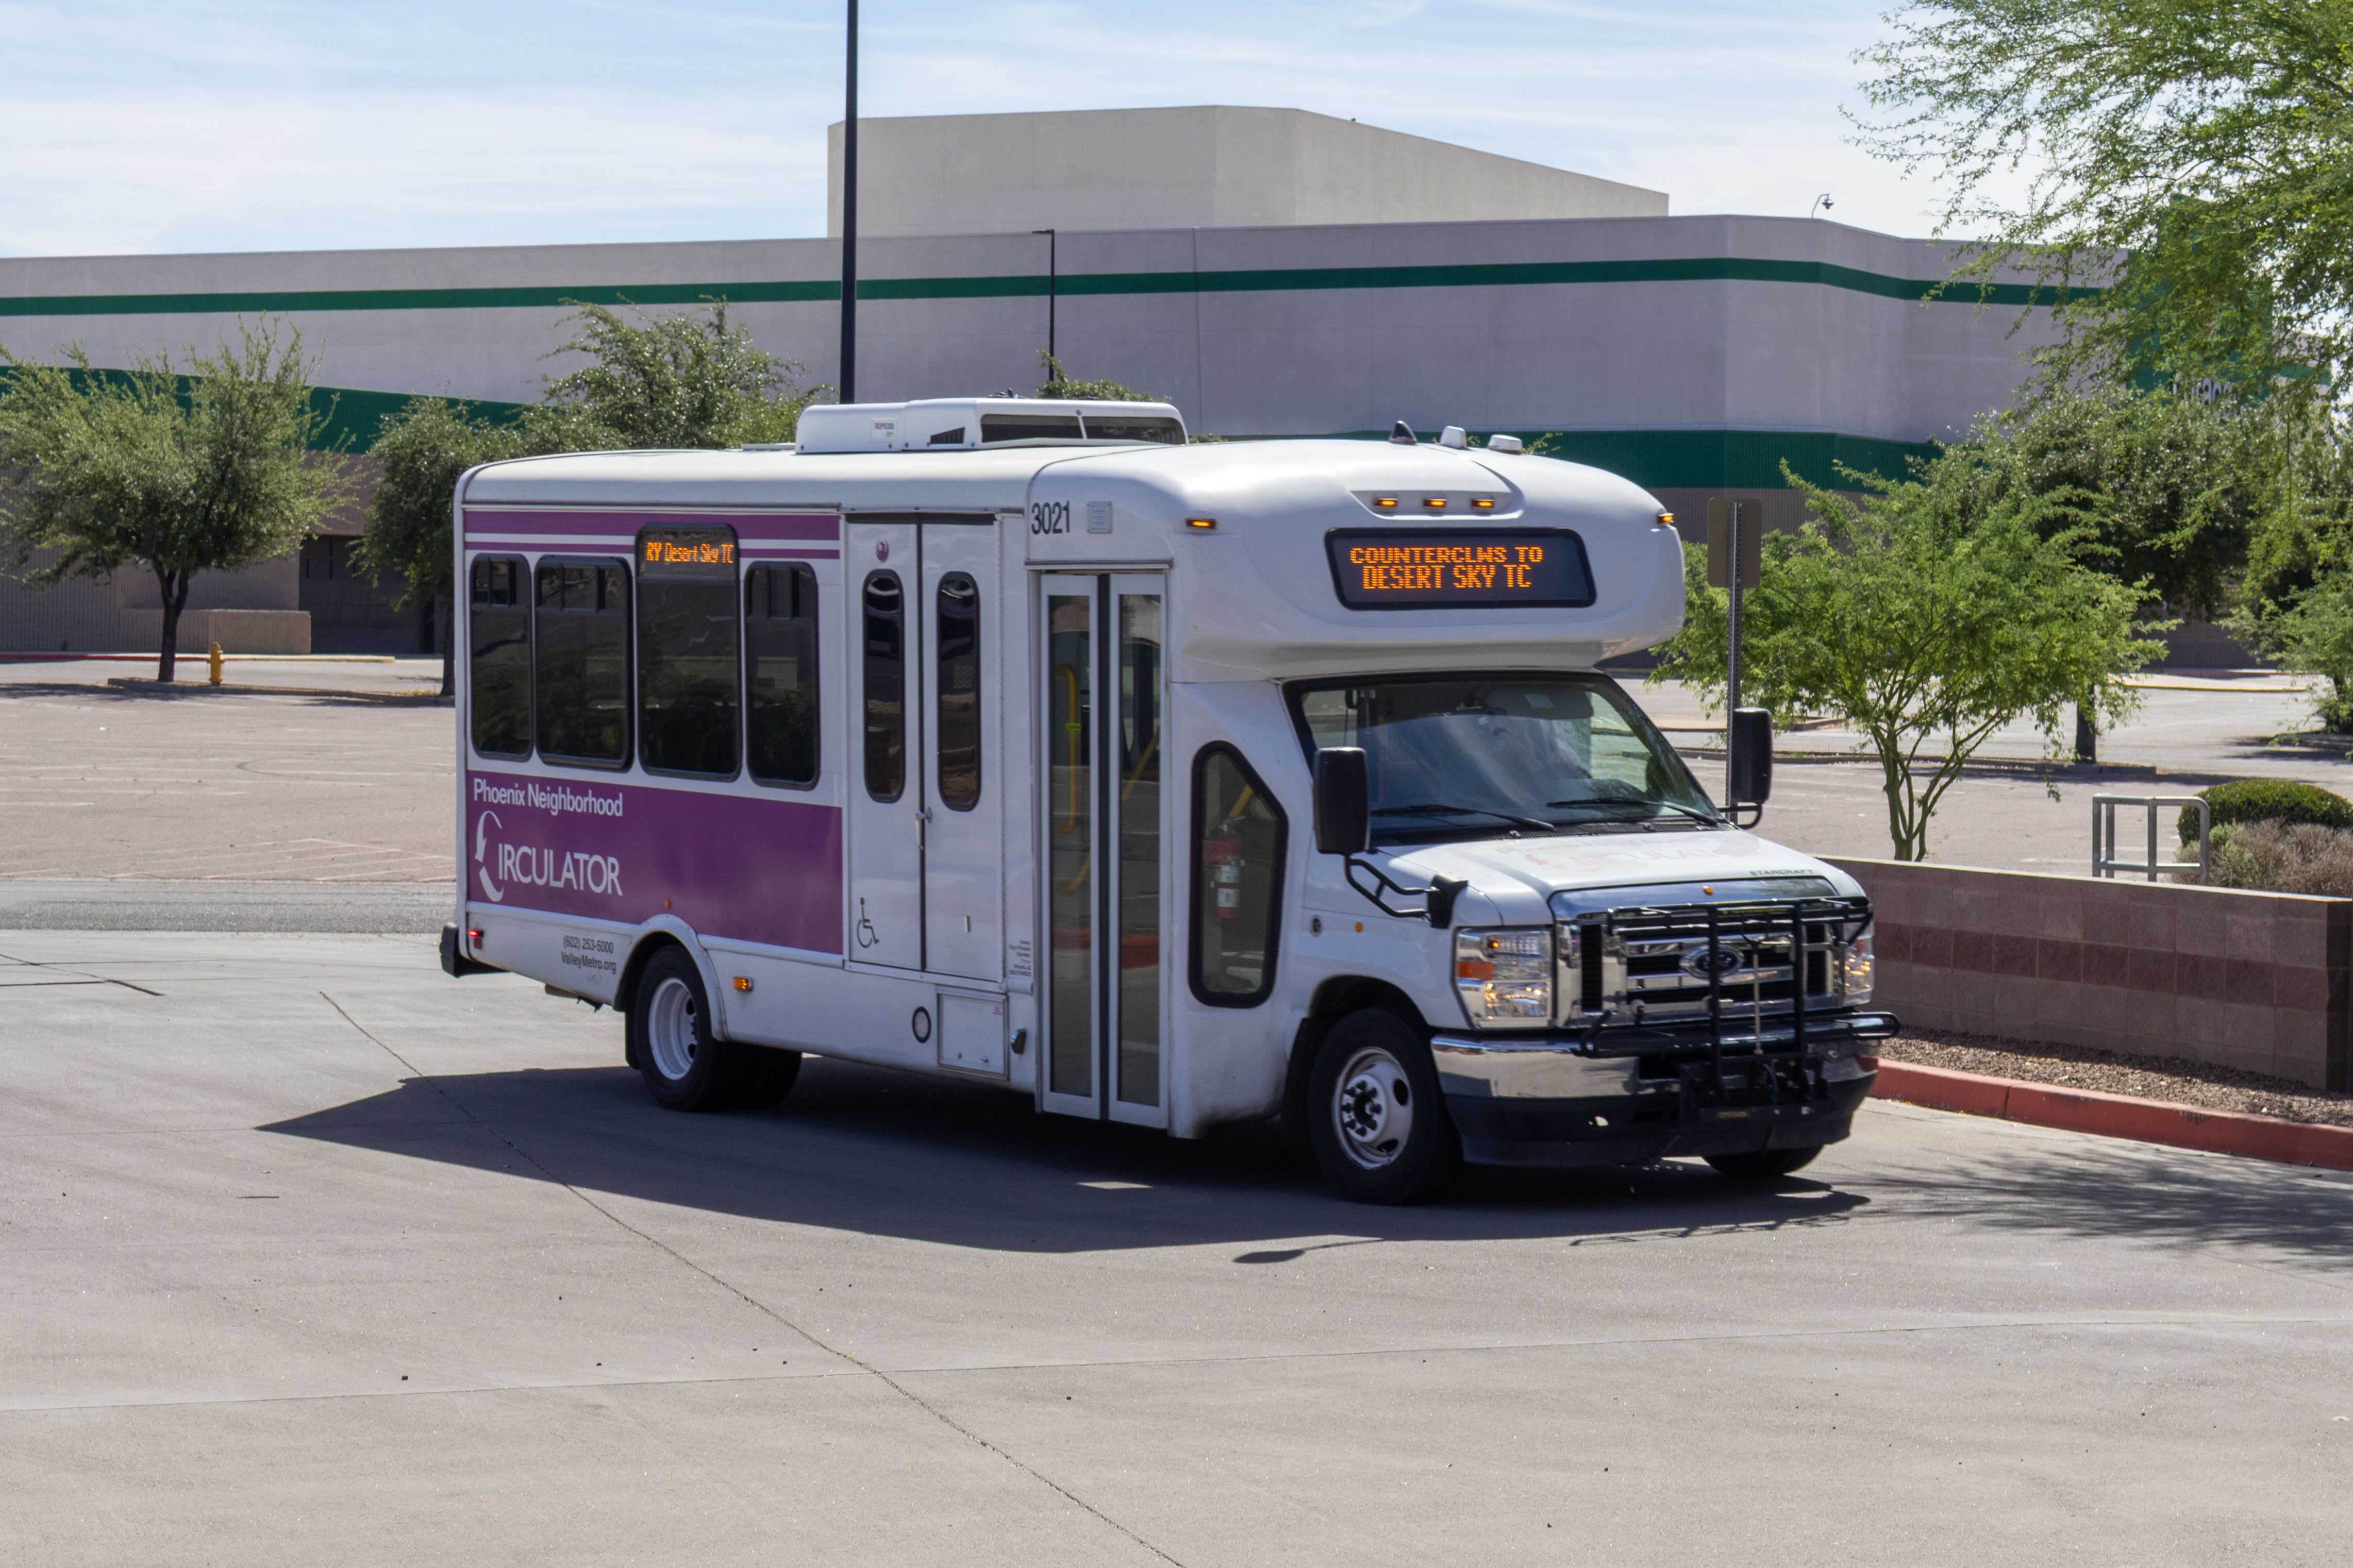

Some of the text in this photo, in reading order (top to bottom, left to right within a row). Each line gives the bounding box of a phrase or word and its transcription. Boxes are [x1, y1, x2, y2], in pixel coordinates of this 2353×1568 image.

[1031, 500, 1071, 534] 3021
[664, 542, 698, 563] Desert
[700, 544, 719, 563] Sky
[721, 544, 735, 564] TC
[1349, 546, 1544, 564] COUNTERCLWS TO
[1362, 564, 1532, 589] DESERT SKY TC
[474, 778, 623, 817] Phoenix Neighborhood
[563, 935, 614, 954] (602) 253-5000
[561, 950, 616, 975] ValleyMetro.org
